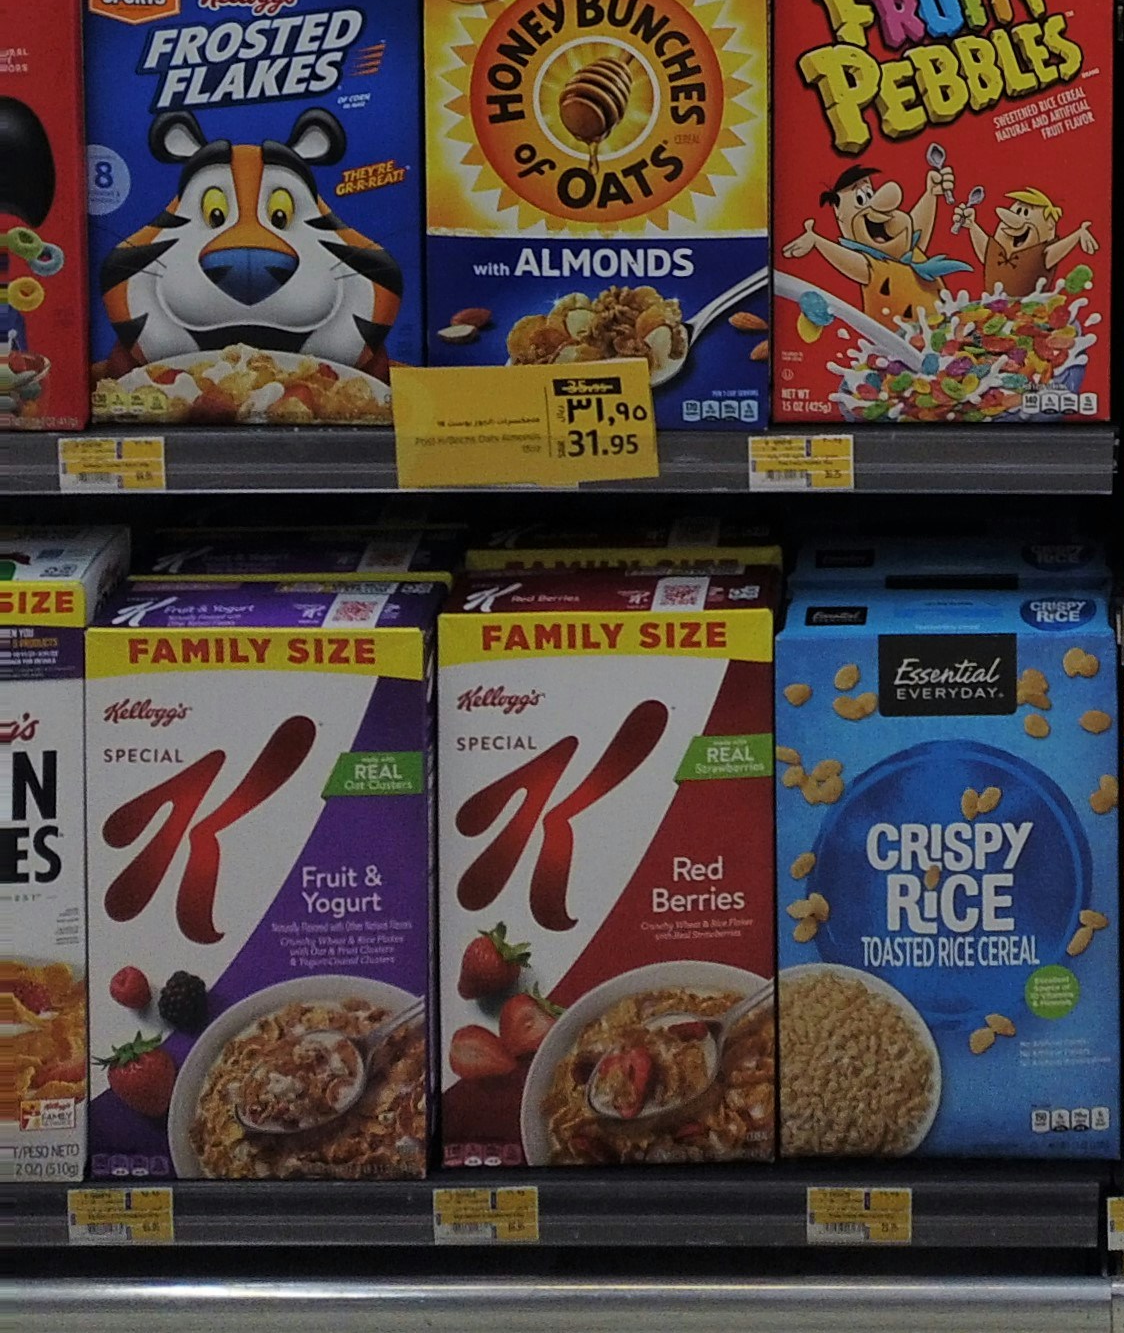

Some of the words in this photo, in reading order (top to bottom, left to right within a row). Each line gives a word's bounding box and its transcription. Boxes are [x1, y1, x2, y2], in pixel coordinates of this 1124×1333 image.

[143, 10, 364, 70] FROSTED
[156, 50, 343, 108] FLAKES
[557, 143, 684, 209] OATS
[513, 247, 694, 278] ALMONDS
[568, 430, 639, 457] 31.95
[129, 639, 272, 664] FAMILY
[287, 638, 376, 664] SIZE
[894, 658, 1000, 686] Essential
[897, 688, 999, 700] EVERYDAY
[867, 822, 1033, 872] CRISPY
[301, 865, 358, 888] Fruit
[673, 858, 724, 881] Red
[301, 891, 383, 918] Yogurt
[652, 888, 746, 913] Berries
[888, 874, 1014, 934] RICE
[862, 936, 935, 966] TOASTED
[937, 936, 974, 966] RICE
[976, 935, 1039, 965] CEREAL
